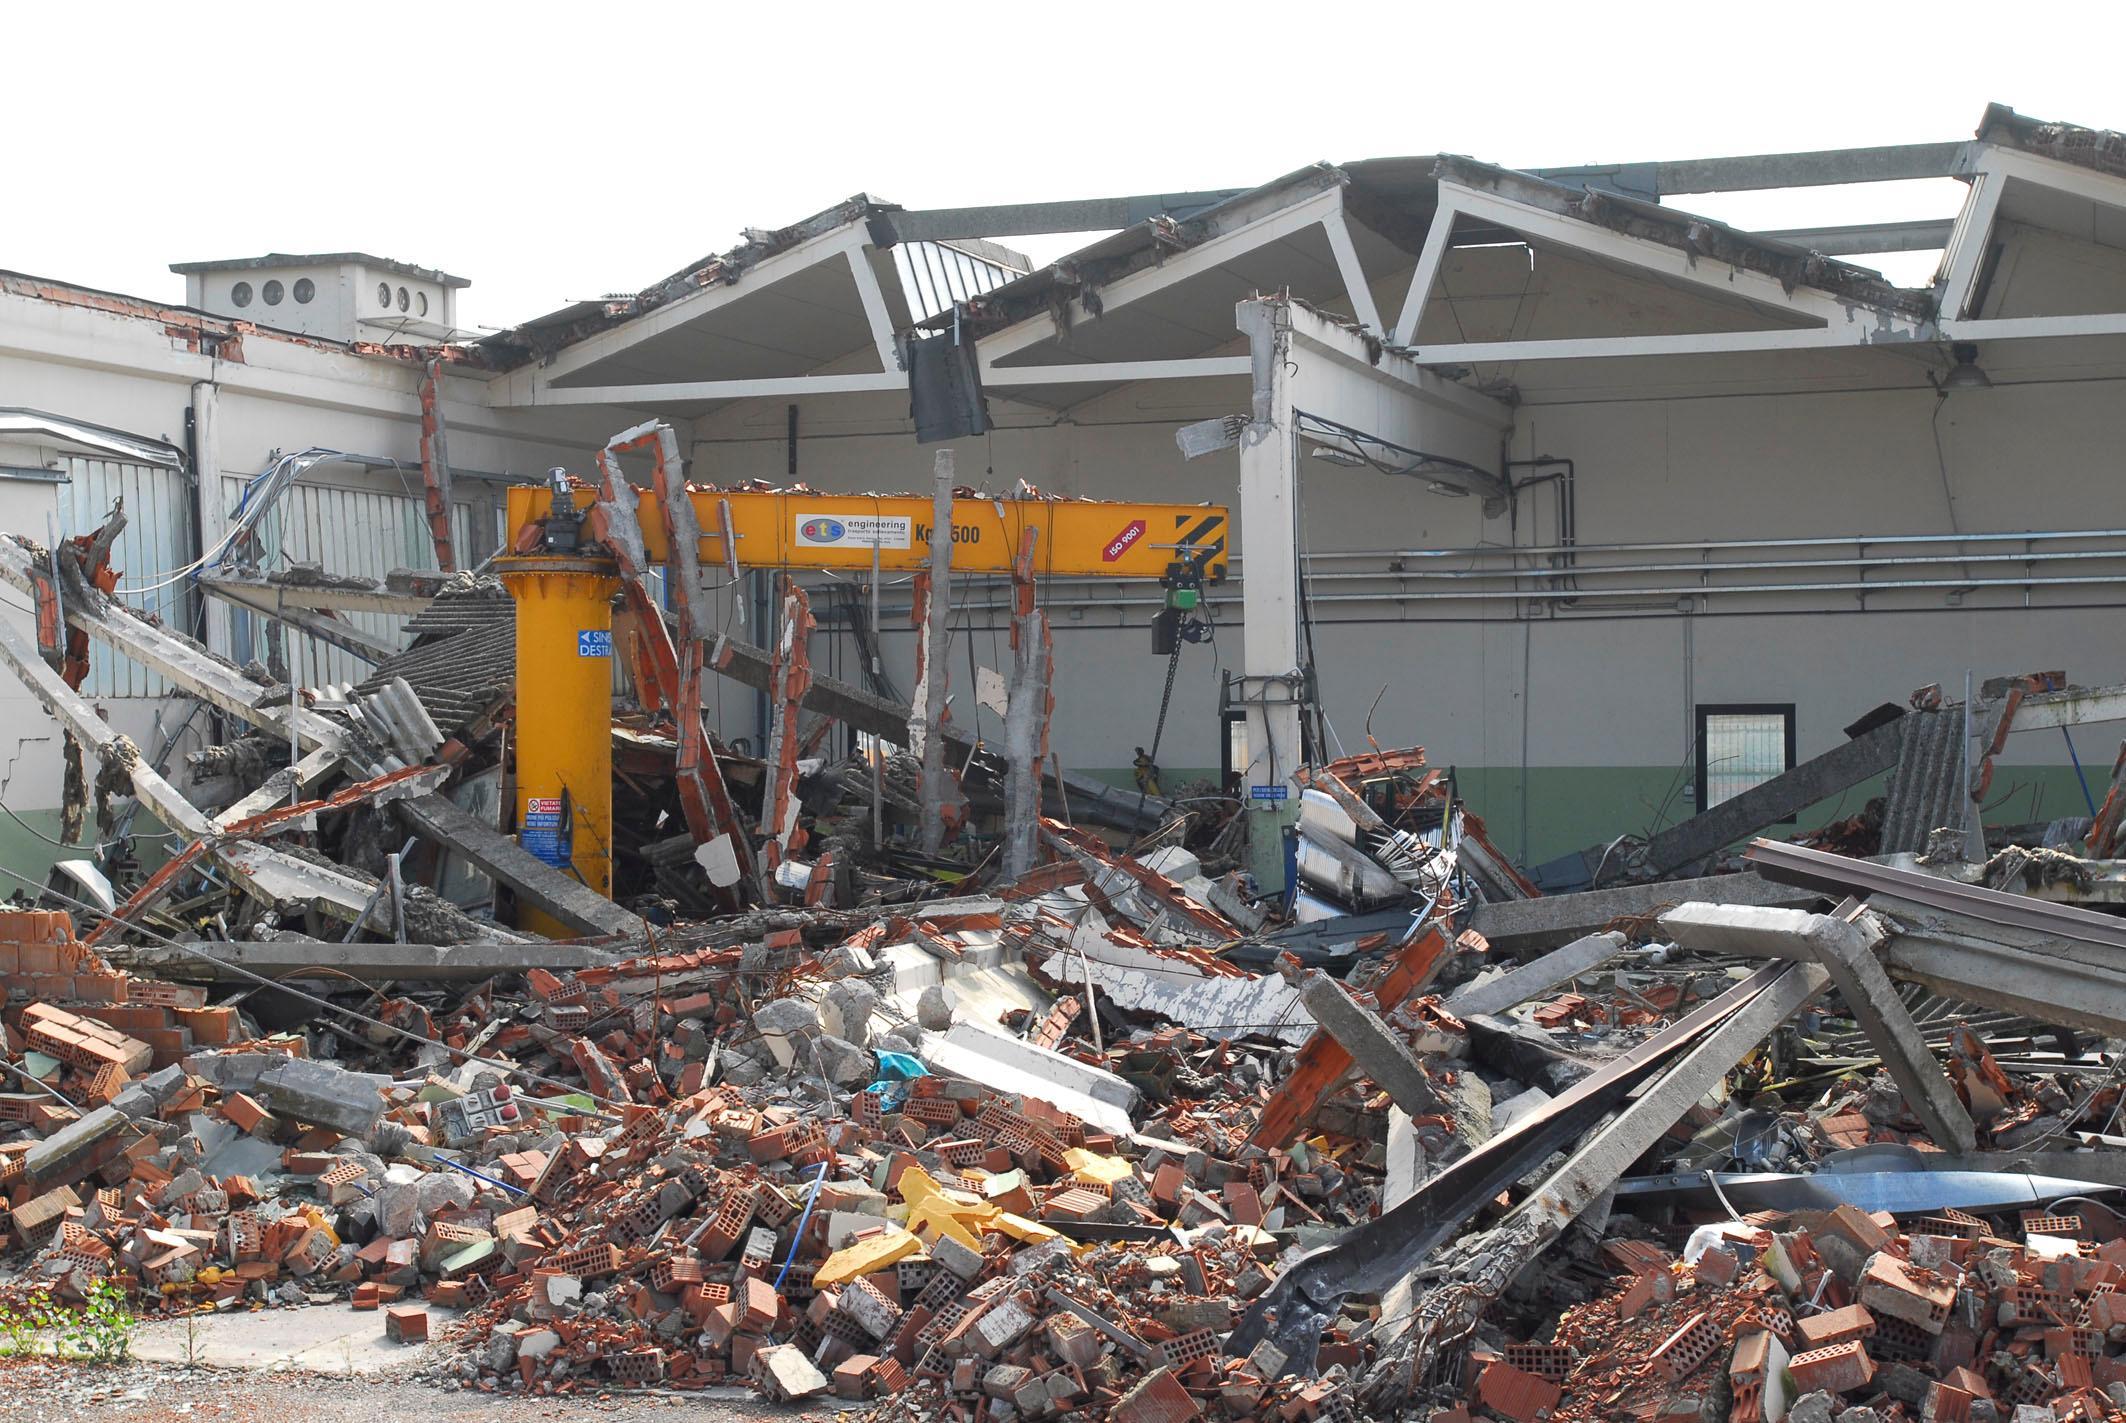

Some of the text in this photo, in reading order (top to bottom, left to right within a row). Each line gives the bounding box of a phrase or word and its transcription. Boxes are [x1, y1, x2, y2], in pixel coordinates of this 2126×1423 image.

[805, 522, 842, 537] ets
[848, 518, 906, 530] engineering
[950, 525, 980, 544] 500
[1109, 526, 1140, 556] ISO 9001
